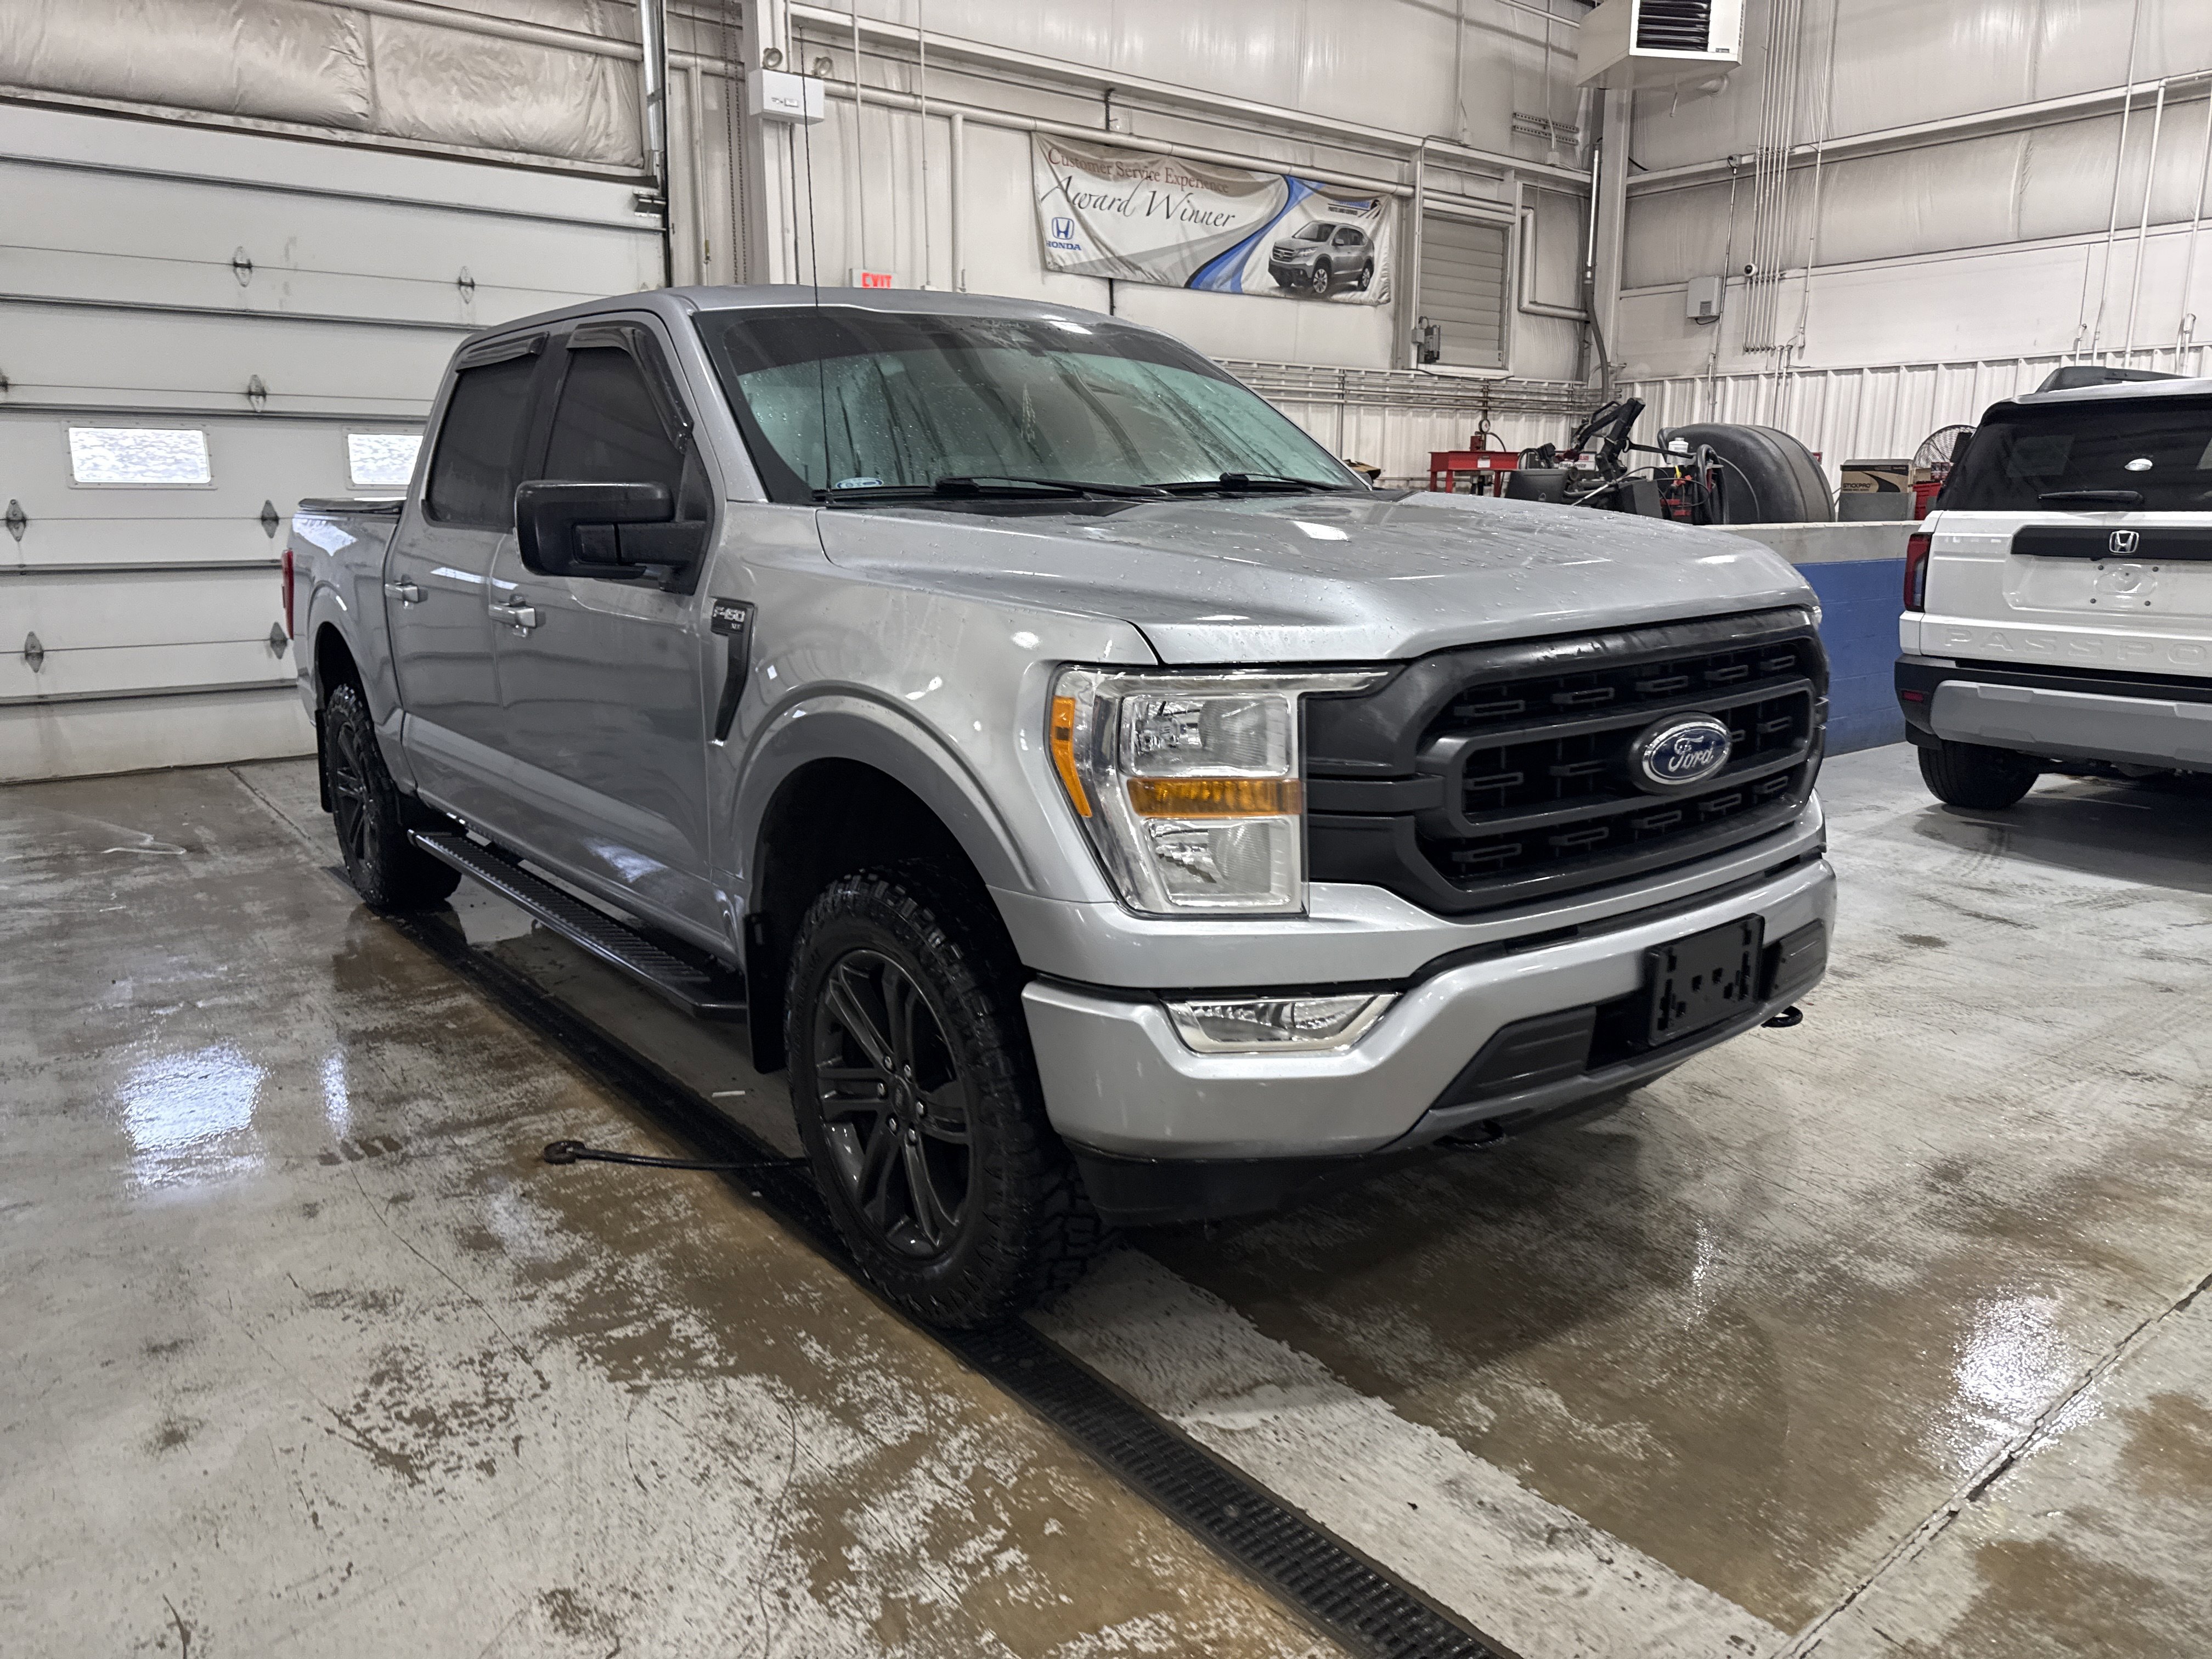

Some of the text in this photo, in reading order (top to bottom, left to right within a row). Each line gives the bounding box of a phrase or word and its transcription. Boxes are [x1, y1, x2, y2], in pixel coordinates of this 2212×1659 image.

[1048, 147, 1229, 193] Customer Service Experience
[1041, 174, 1235, 227] Award Winner
[1046, 240, 1082, 251] HONDA
[862, 273, 891, 289] EXIT
[1668, 735, 1716, 772] Ford
